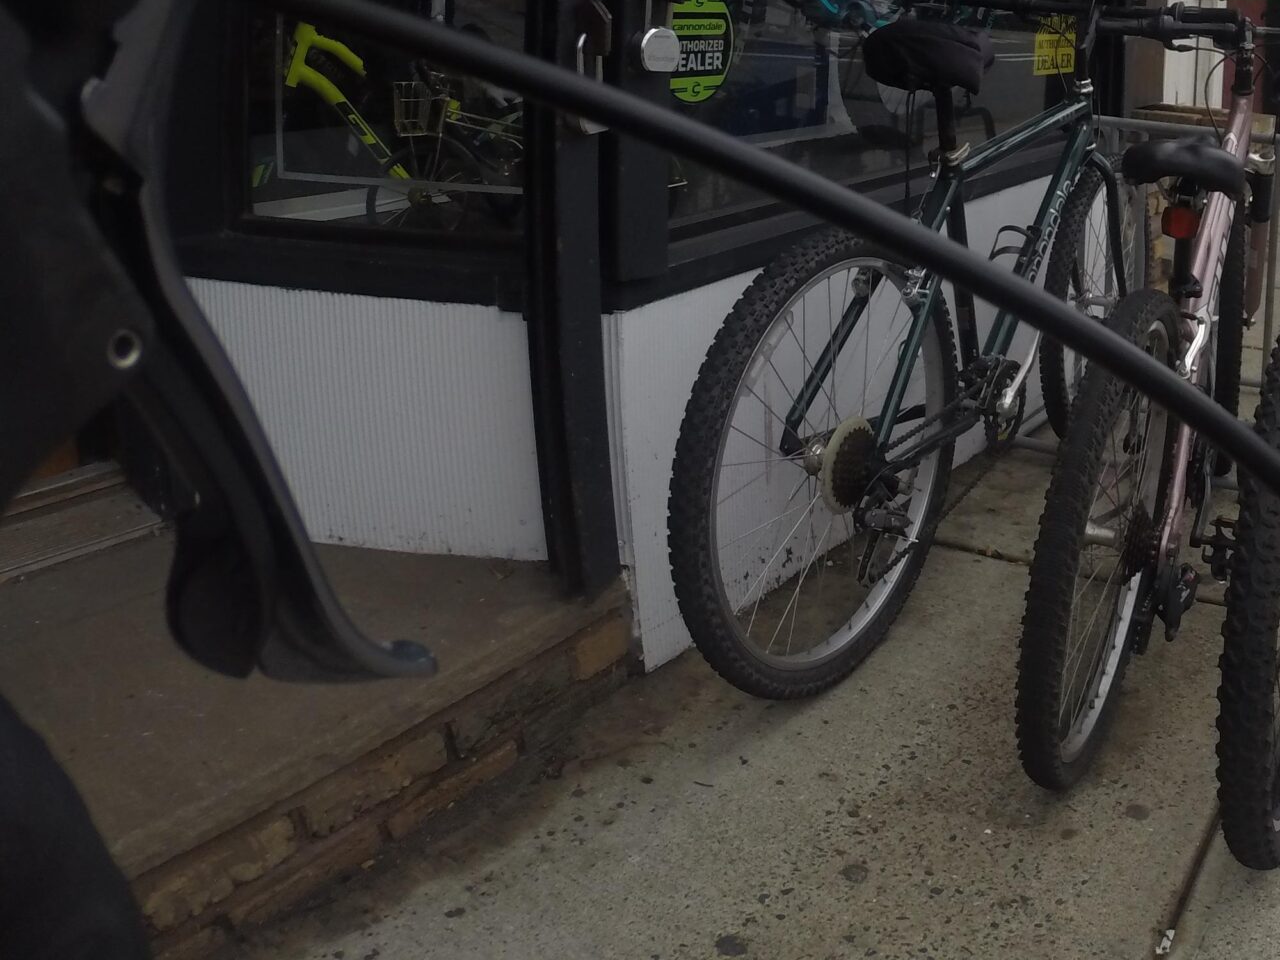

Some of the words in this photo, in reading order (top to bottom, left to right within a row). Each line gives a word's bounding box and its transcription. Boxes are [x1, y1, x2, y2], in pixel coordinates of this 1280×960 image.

[672, 22, 723, 32] cannondale
[679, 39, 724, 52] UTHORIZED
[678, 52, 723, 71] EALER
